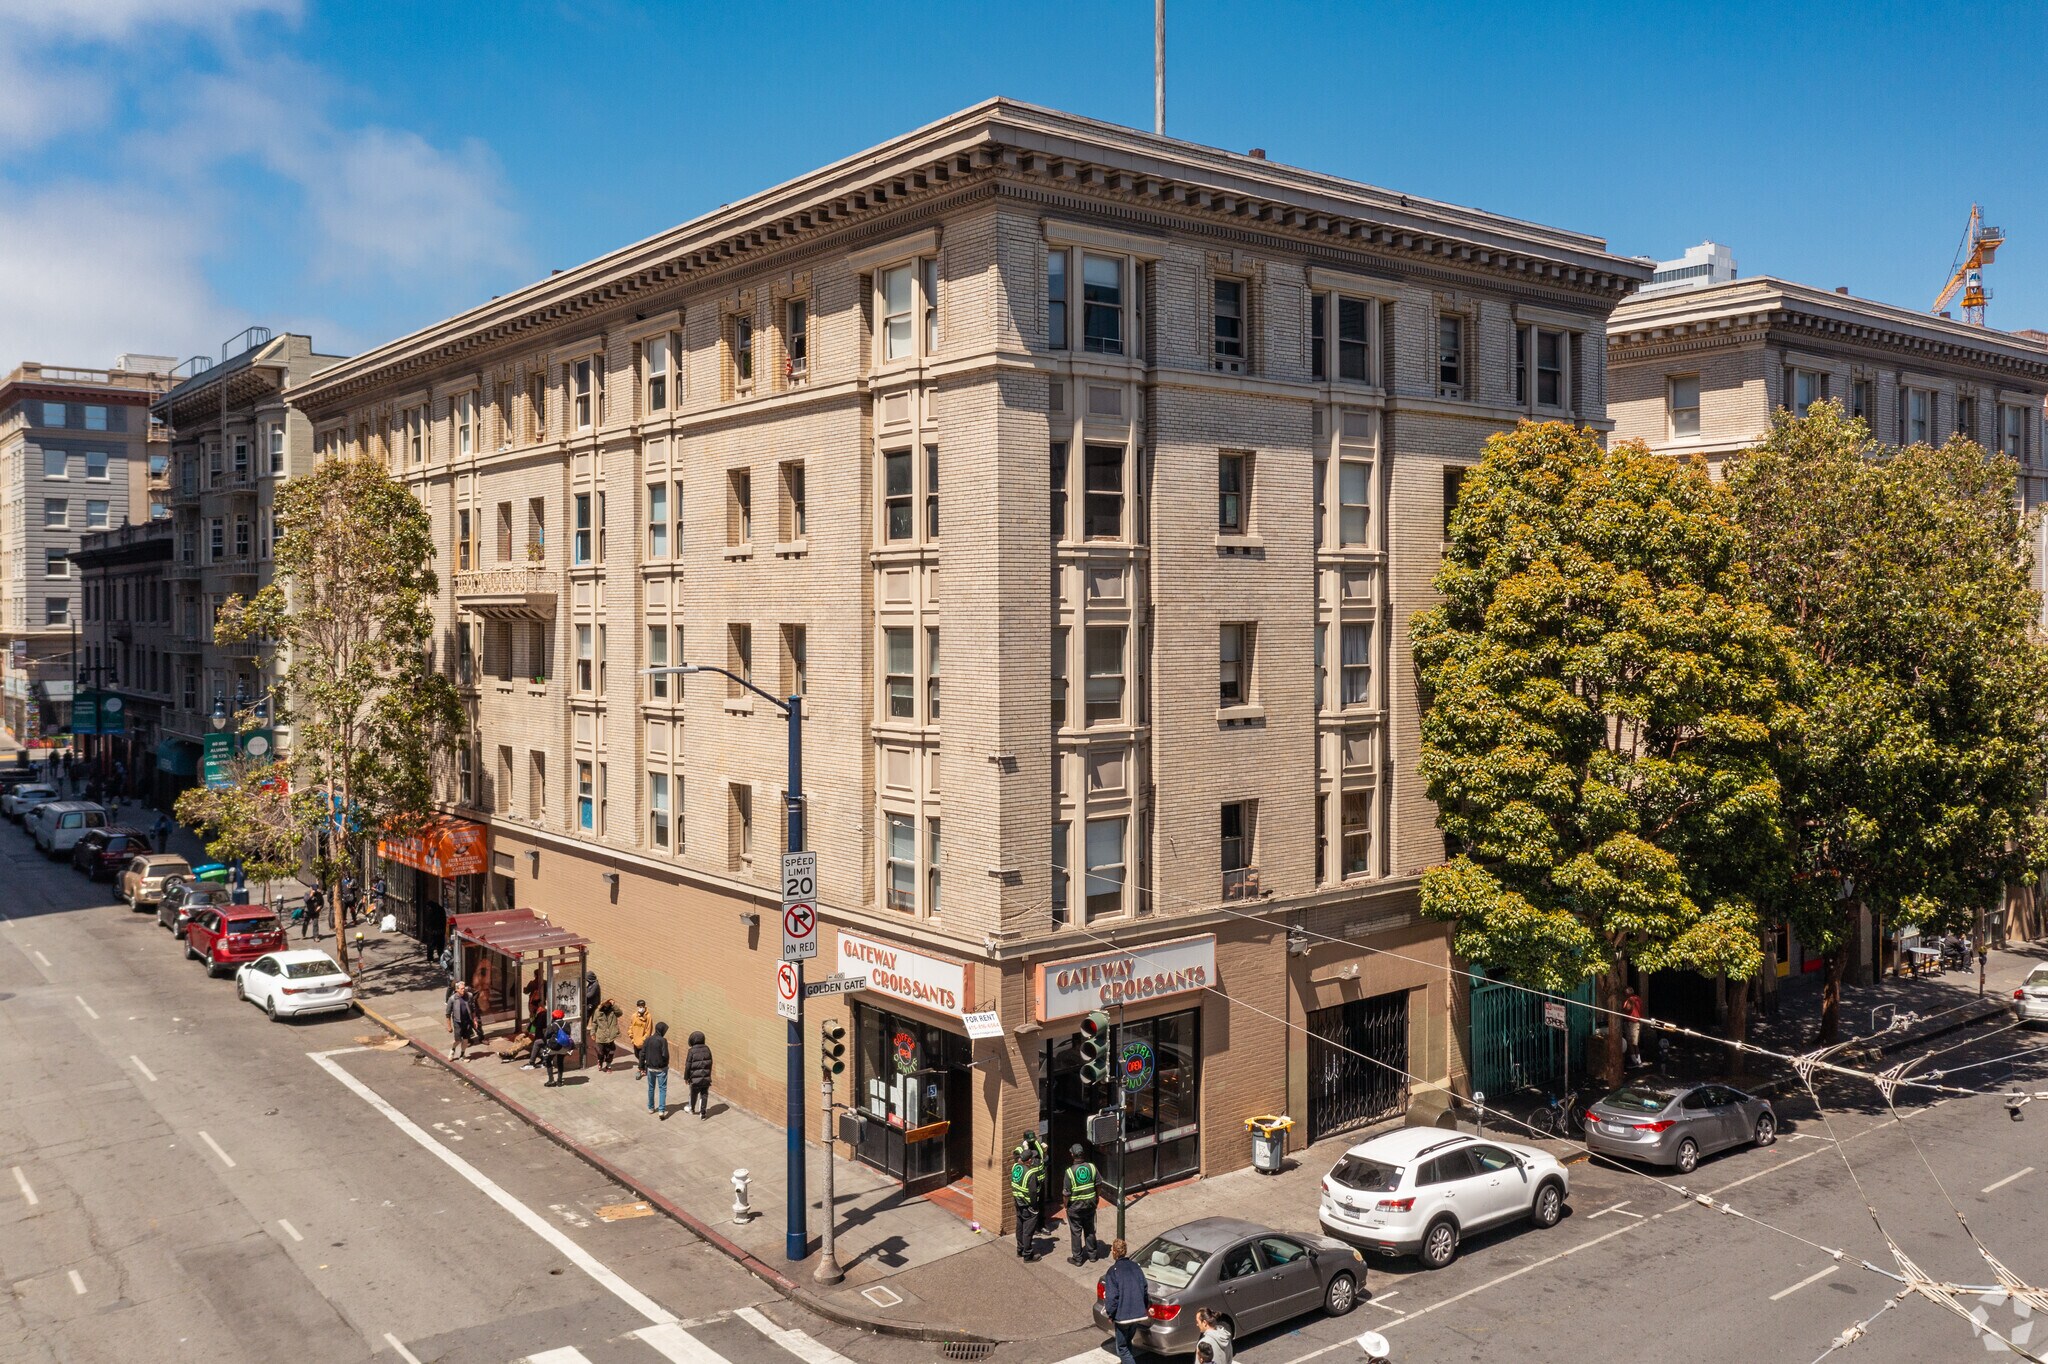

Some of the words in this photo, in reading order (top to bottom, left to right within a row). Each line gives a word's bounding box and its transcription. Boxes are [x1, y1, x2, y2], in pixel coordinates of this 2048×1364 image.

[785, 857, 814, 867] SPEED
[788, 867, 811, 877] LIMIT
[786, 877, 813, 896] 20
[785, 944, 796, 954] ON
[799, 941, 815, 952] RED
[843, 939, 897, 971] GATEWAY
[1056, 958, 1135, 989] GATEWAY
[807, 983, 841, 996] GOLDEN
[844, 979, 865, 991] GATE
[872, 968, 956, 1009] CROISSANTS
[1099, 965, 1206, 1002] CROISSANTS
[779, 1001, 786, 1011] ON
[786, 1004, 796, 1015] RED
[965, 1015, 979, 1024] FOR
[979, 1013, 996, 1022] RENT
[893, 1033, 915, 1050] COFFEE
[899, 1048, 911, 1060] OPEN
[1122, 1043, 1152, 1061] ASTRY
[893, 1053, 918, 1074] DONUTS
[1127, 1060, 1143, 1072] OPEN
[1122, 1066, 1152, 1089] NUTS
